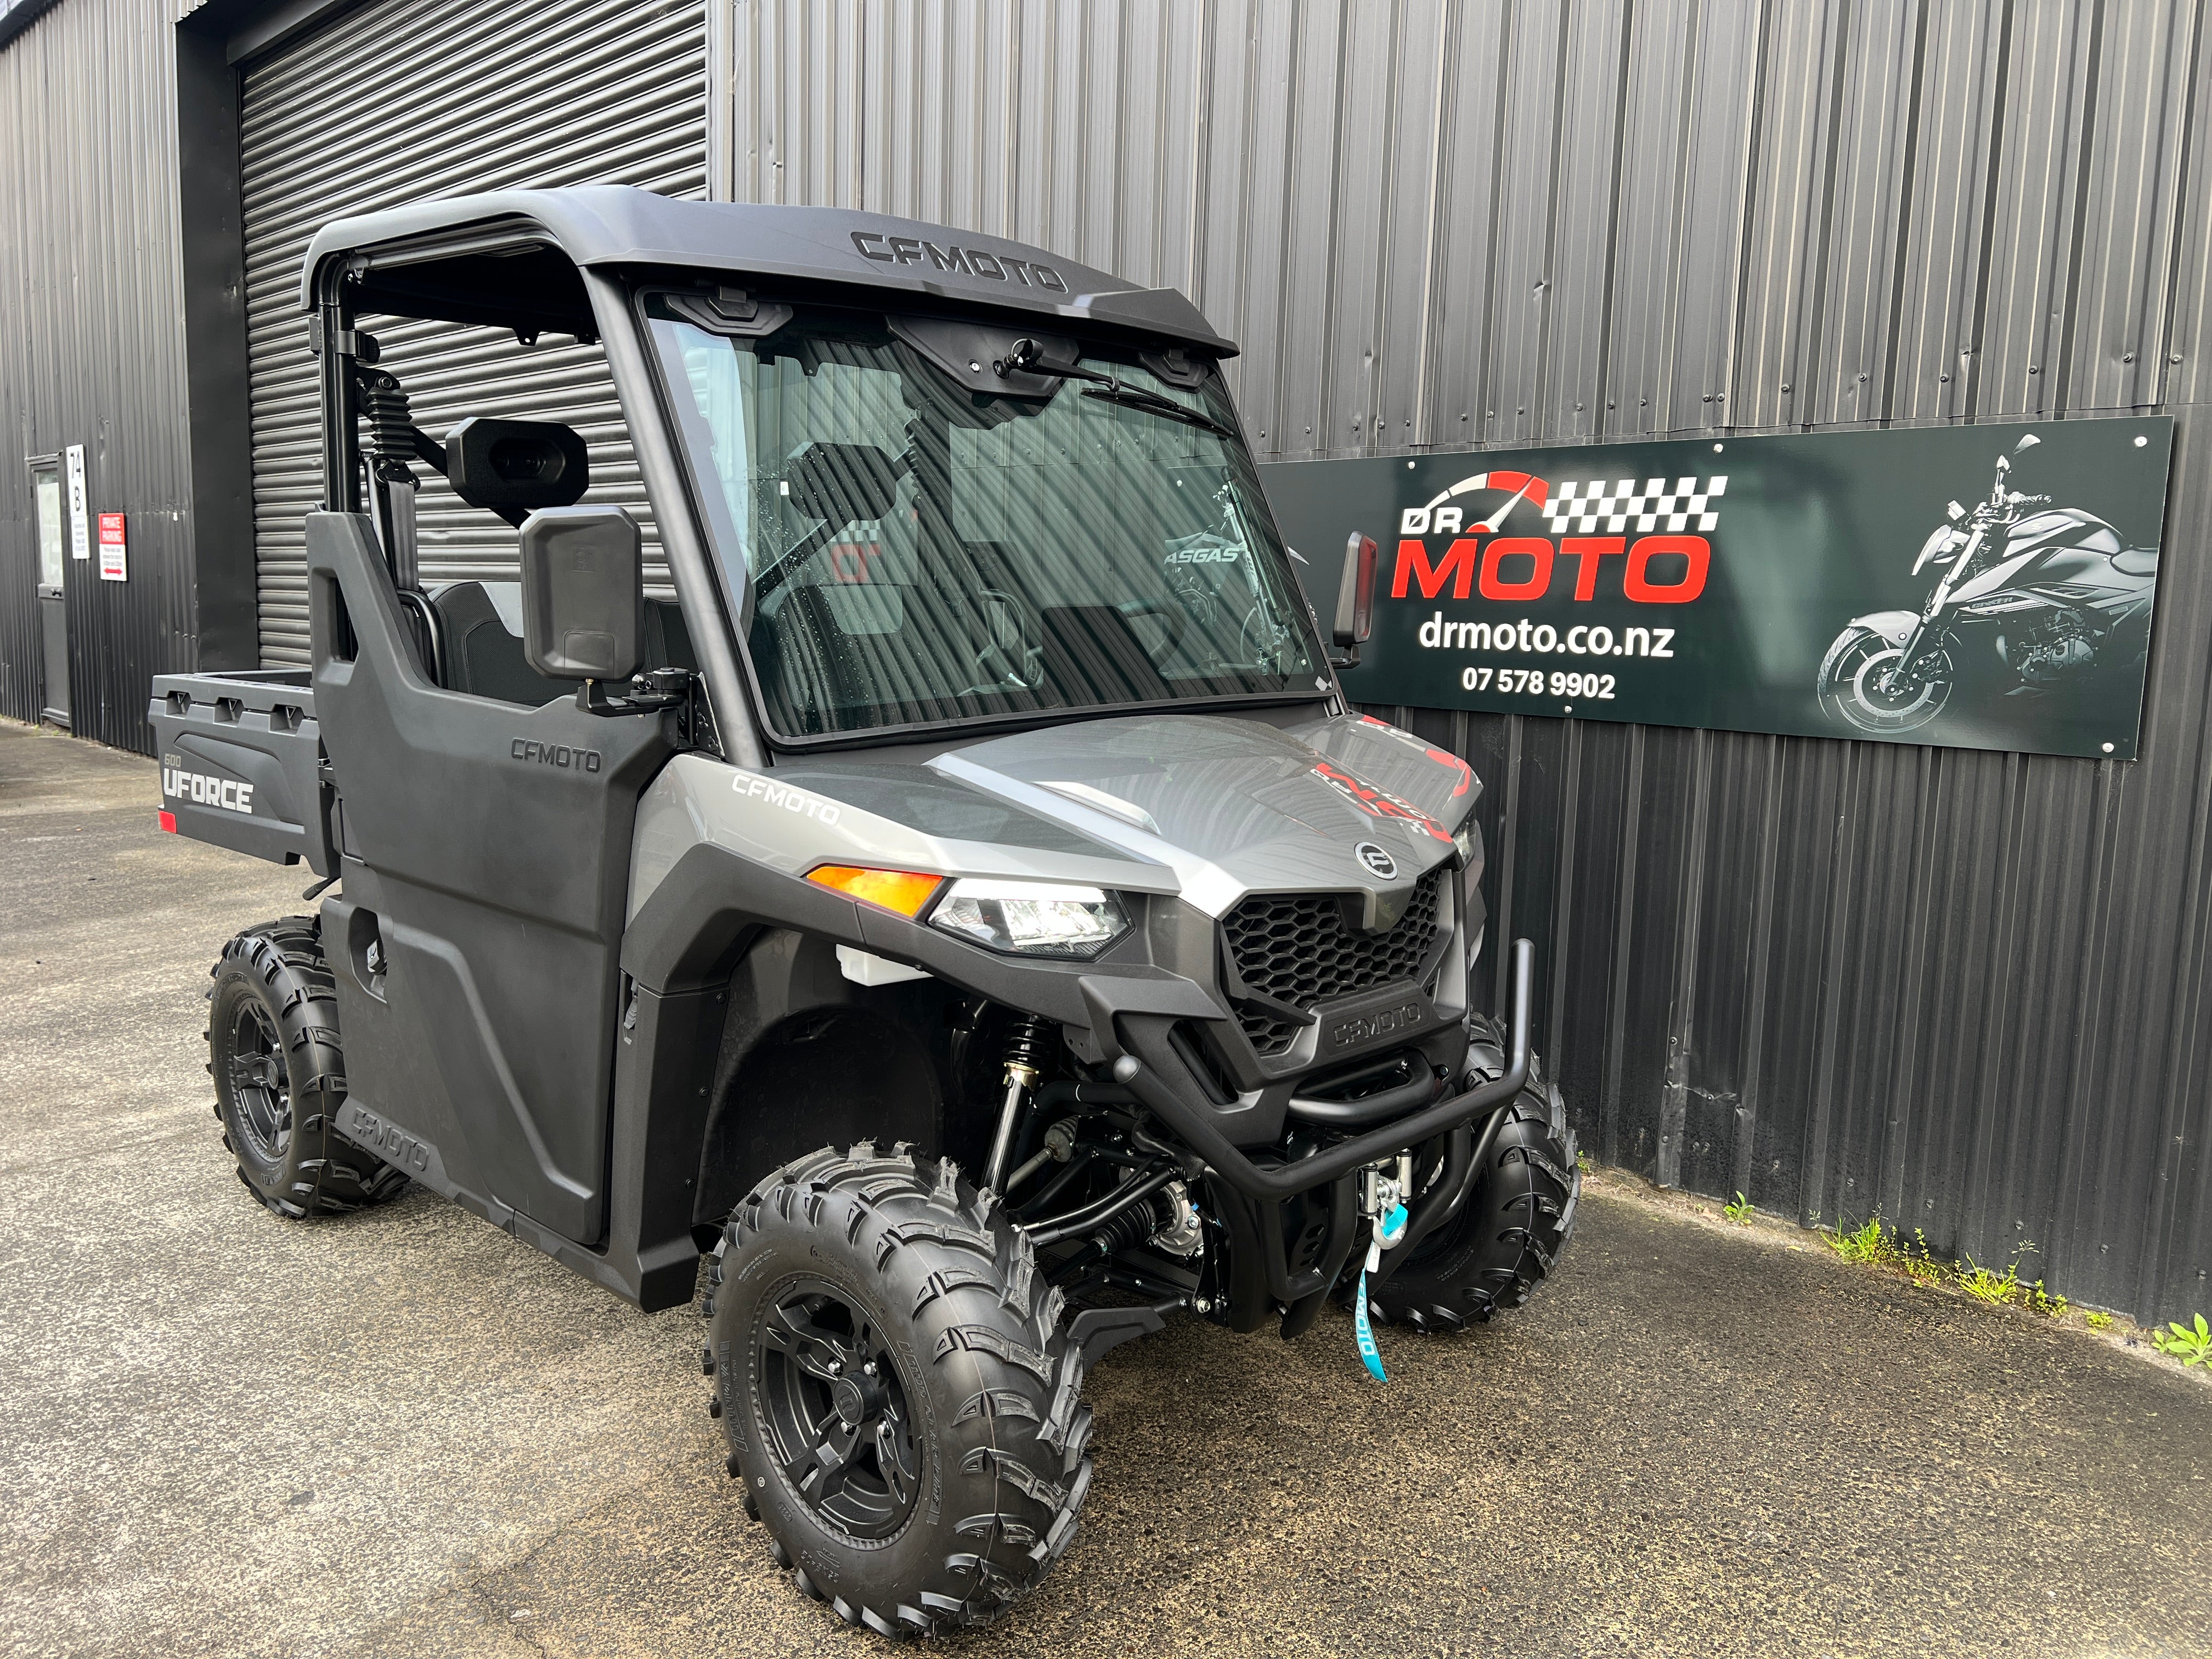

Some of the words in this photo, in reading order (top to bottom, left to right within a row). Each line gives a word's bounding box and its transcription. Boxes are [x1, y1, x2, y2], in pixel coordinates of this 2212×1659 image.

[850, 231, 1068, 294] CFMOTO
[70, 451, 81, 478] 74
[1391, 535, 1711, 603] MOTO
[1419, 611, 1675, 658] drmoto.co.nz
[1463, 667, 1493, 691] 07
[1498, 669, 1544, 695] 578
[1550, 672, 1616, 699] 9902
[165, 753, 182, 768] 600
[511, 737, 602, 774] CFMOTO
[163, 768, 254, 814] UFORCE
[731, 774, 841, 827] CFMOTO
[1334, 1002, 1421, 1047] CFMOTO
[353, 1107, 430, 1172] CFMOTO
